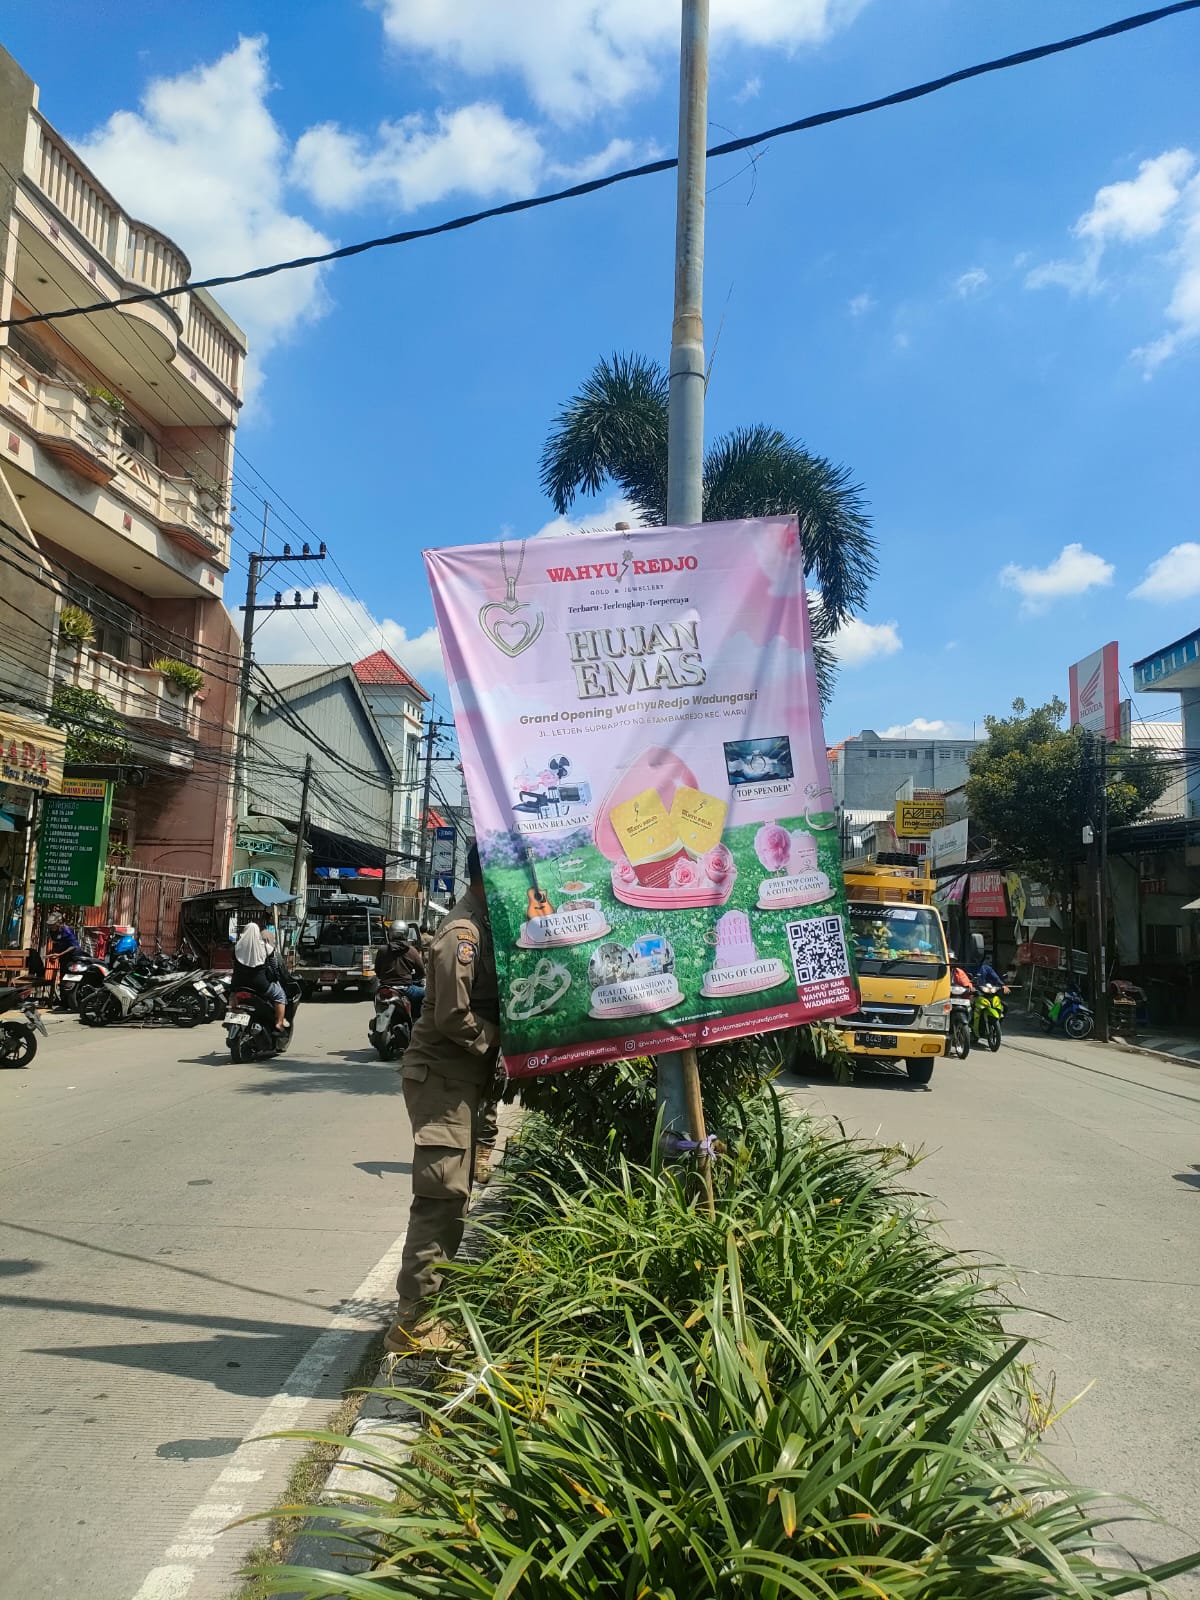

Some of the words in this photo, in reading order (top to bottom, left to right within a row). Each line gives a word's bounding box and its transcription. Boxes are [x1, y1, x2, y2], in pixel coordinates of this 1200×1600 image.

[546, 562, 618, 583] WAHYU
[632, 555, 698, 575] REDJO
[624, 584, 665, 593] JEWELLERY
[566, 620, 700, 664] HUJAN
[571, 651, 707, 701] EMAS
[519, 712, 559, 725] Grand
[560, 707, 613, 723] Opening
[692, 689, 758, 705] Wadungasri
[1080, 701, 1103, 718] HONDA
[552, 727, 583, 737] LETJEN
[585, 719, 631, 733] SUPRAPTO
[723, 708, 747, 717] WARU
[736, 788, 752, 798] TOP
[539, 918, 560, 928] LIVE
[562, 912, 591, 925] MUSIC
[544, 929, 552, 937] &
[553, 923, 590, 936] CANAPE
[711, 971, 735, 983] RING
[735, 968, 748, 978] OF
[597, 986, 627, 998] BEAUTY
[629, 980, 665, 993] TALKSHOW
[801, 990, 827, 1002] WAHYU
[828, 987, 850, 997] REDJO
[803, 985, 820, 993] SCAN
[820, 983, 830, 991] QR
[830, 980, 845, 988] KAMI
[804, 994, 850, 1009] WADUNGASRI
